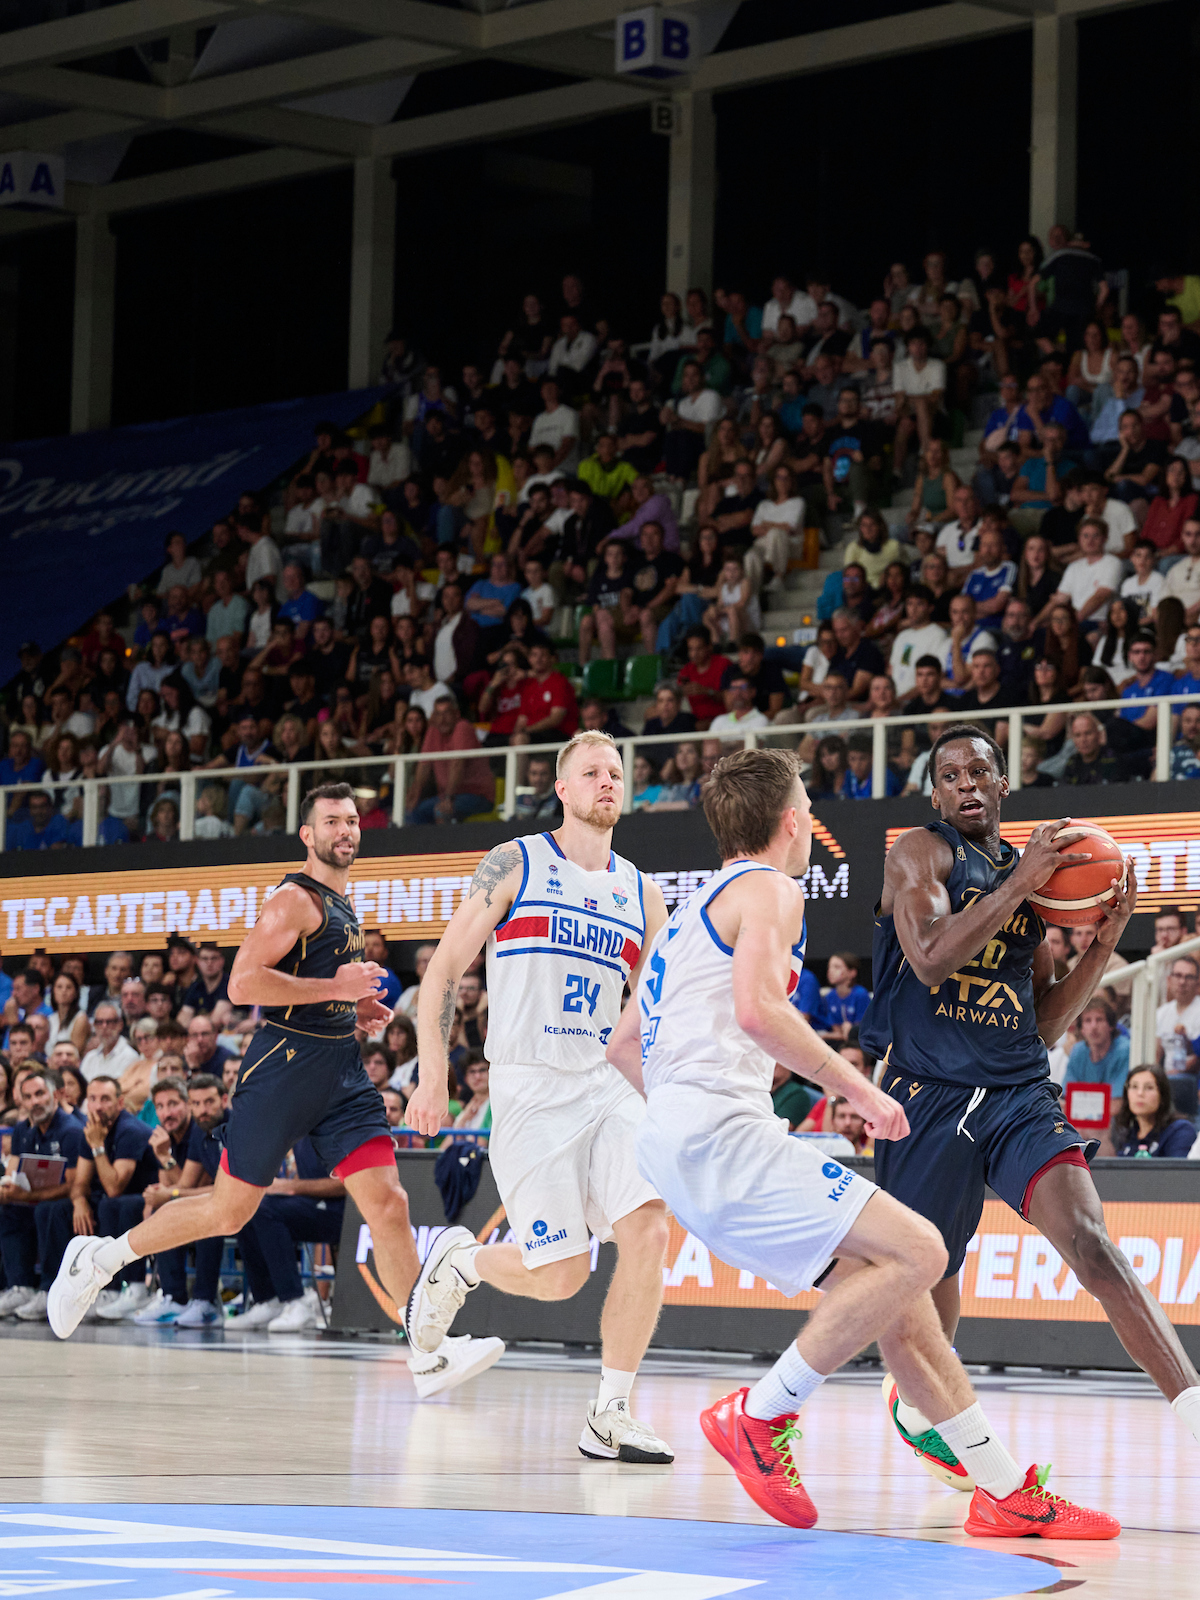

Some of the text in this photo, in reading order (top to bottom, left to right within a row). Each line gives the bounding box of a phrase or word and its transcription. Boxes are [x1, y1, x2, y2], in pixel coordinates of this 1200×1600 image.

[624, 20, 645, 59] B
[663, 19, 688, 59] B
[0, 163, 14, 194] A
[30, 163, 54, 195] A
[2, 885, 278, 940] TECARTERAPI
[550, 910, 625, 959] ÍSLAND
[563, 974, 601, 1017] 24
[935, 1002, 1020, 1031] AIRWAYS
[525, 1229, 568, 1251] Kristall
